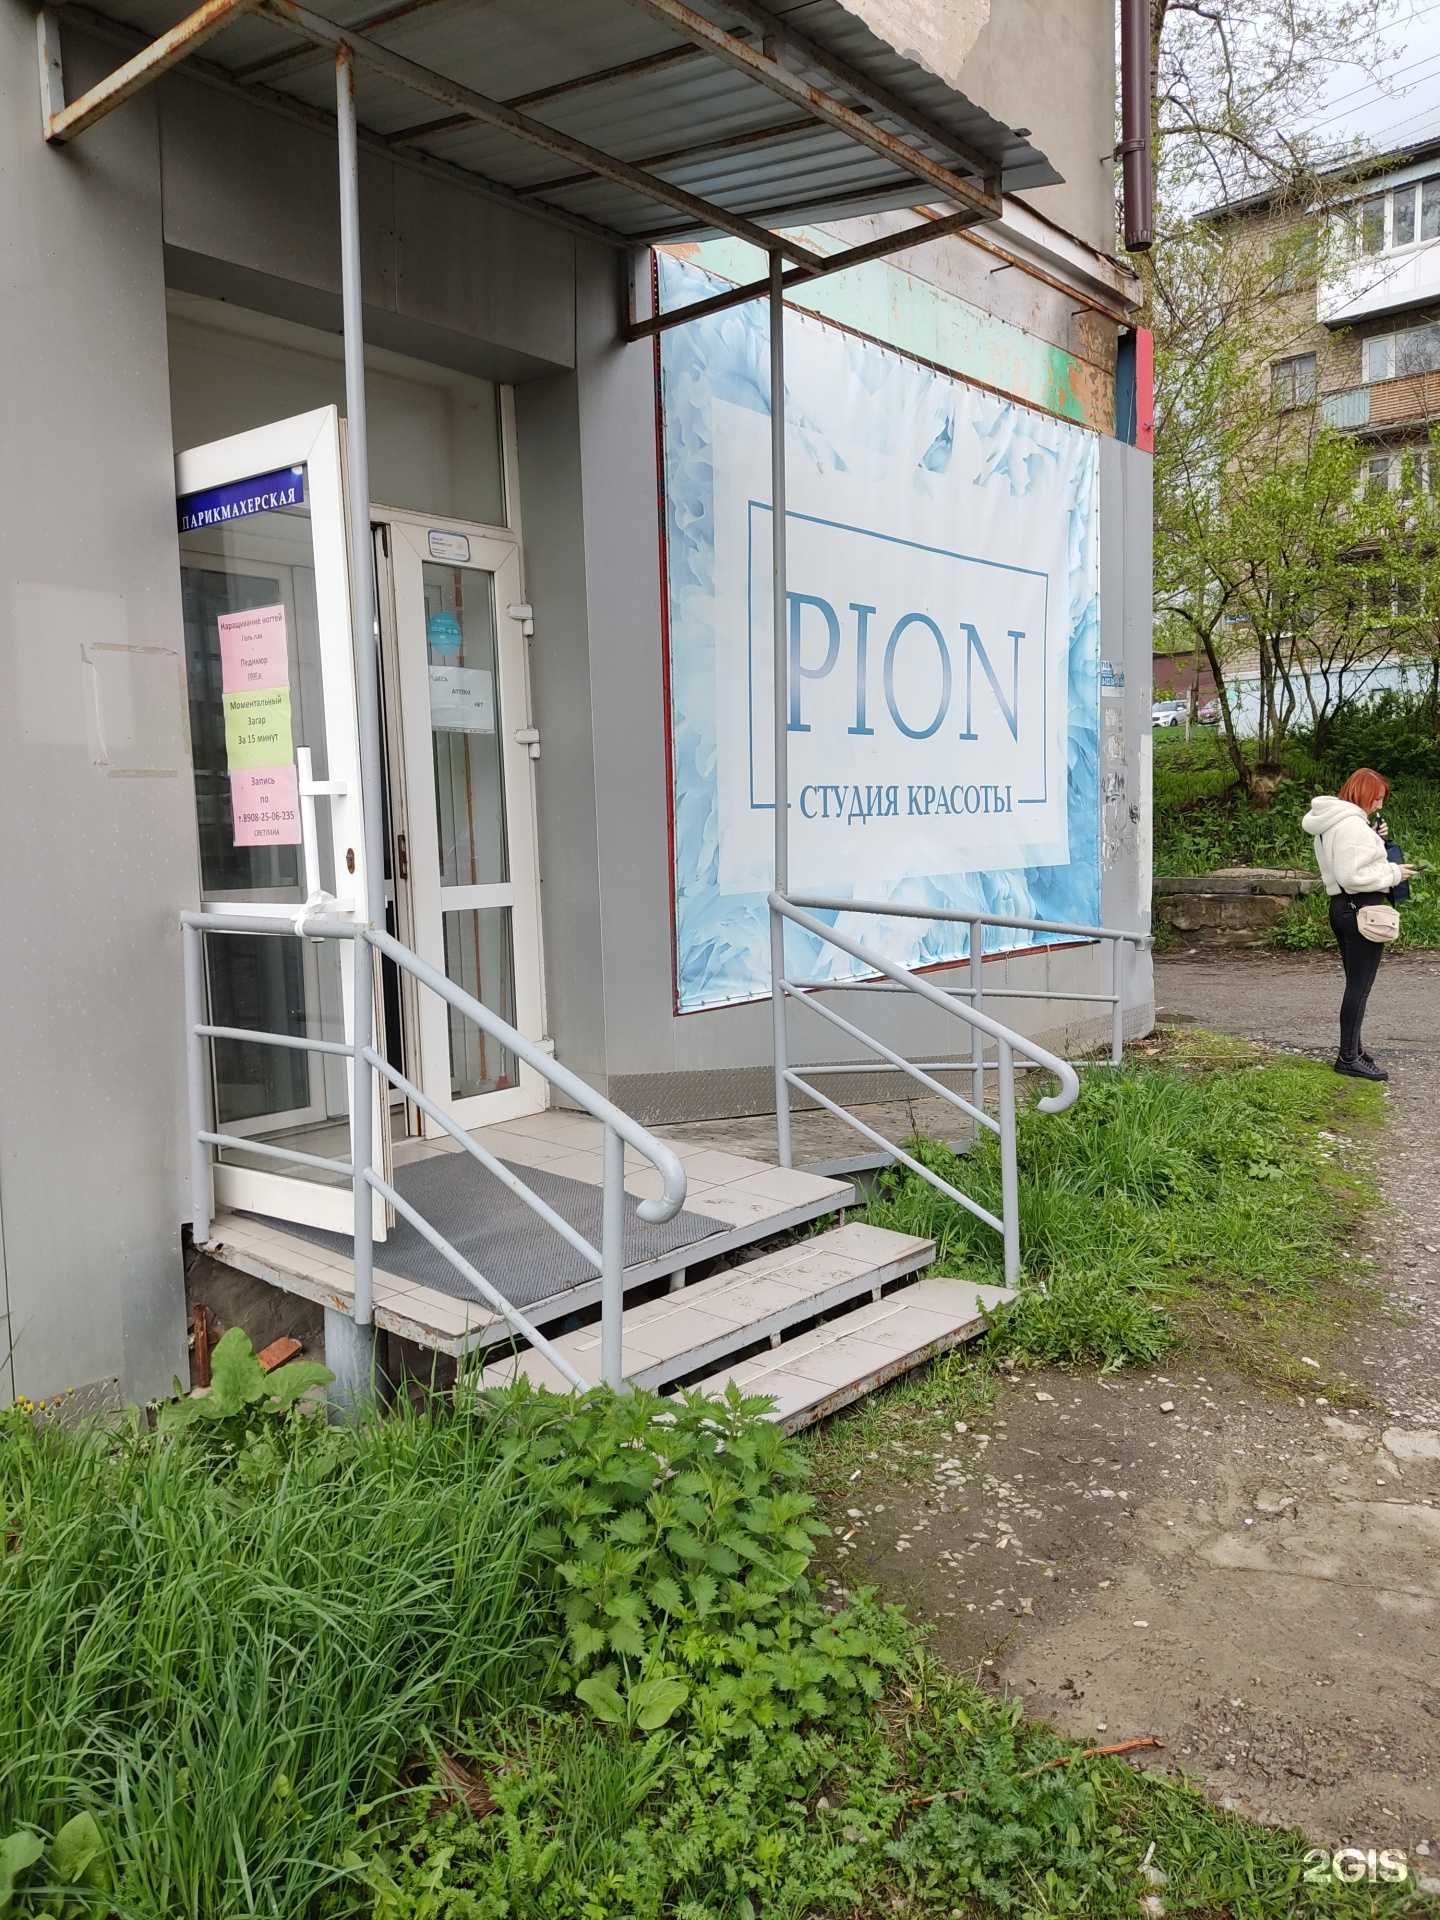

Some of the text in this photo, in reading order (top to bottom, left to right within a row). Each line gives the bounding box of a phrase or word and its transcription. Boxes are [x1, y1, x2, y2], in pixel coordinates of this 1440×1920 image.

[182, 487, 296, 530] ПАРИКМАХЕРСКАЯ
[785, 591, 1026, 744] PION
[230, 695, 282, 710] Моментальный
[247, 716, 266, 727] Загар
[238, 733, 279, 745] За 15 минут
[251, 776, 276, 786] Запись
[259, 795, 269, 804] по
[800, 784, 1012, 826] СТУДИЯ КРАСОТЫ
